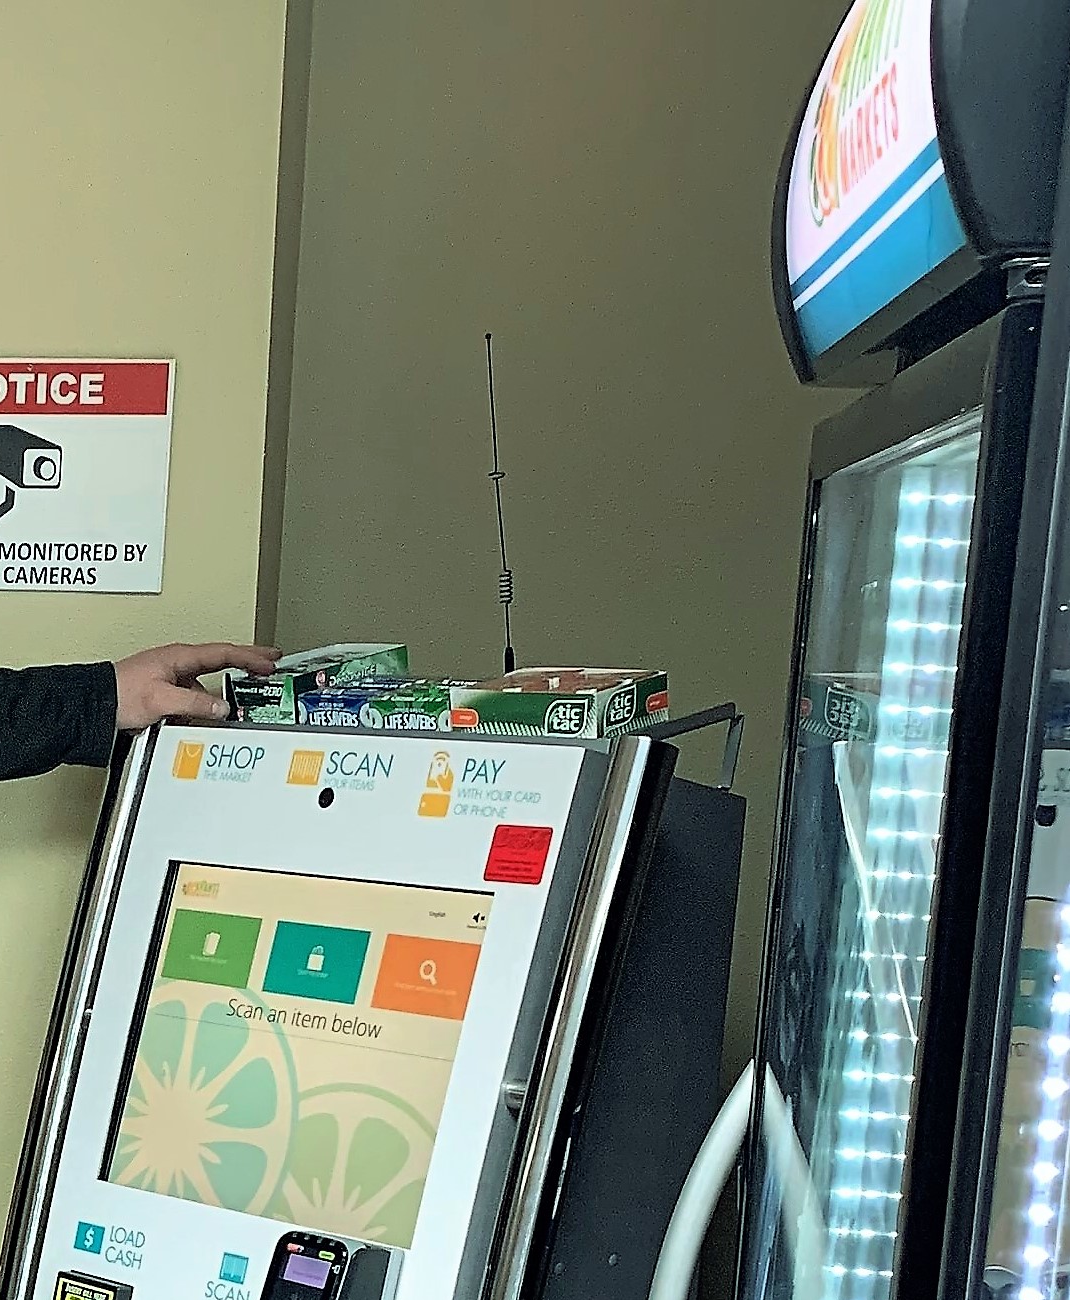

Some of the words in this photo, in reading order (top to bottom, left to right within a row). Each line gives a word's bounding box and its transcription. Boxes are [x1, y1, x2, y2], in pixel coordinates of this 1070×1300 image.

[840, 62, 899, 197] MARKETS
[124, 544, 147, 562] BY
[3, 566, 97, 585] CAMERAS
[614, 691, 632, 710] tic
[327, 711, 359, 728] SAVERS
[558, 703, 583, 720] tic
[610, 706, 631, 722] tac
[403, 713, 437, 730] SAVERS
[552, 716, 581, 732] tac
[206, 744, 265, 769] SHOP
[326, 751, 395, 778] SCAN
[461, 757, 507, 784] PAY
[457, 787, 483, 800] WITH
[486, 789, 513, 802] YOUR
[514, 791, 542, 804] CARD
[453, 803, 468, 816] OR
[470, 805, 508, 818] PHONE
[226, 998, 263, 1022] Scan
[267, 1008, 287, 1025] an
[291, 1007, 327, 1031] item
[331, 1013, 383, 1039] below
[109, 1226, 146, 1248] LOAD
[105, 1246, 143, 1270] CASH
